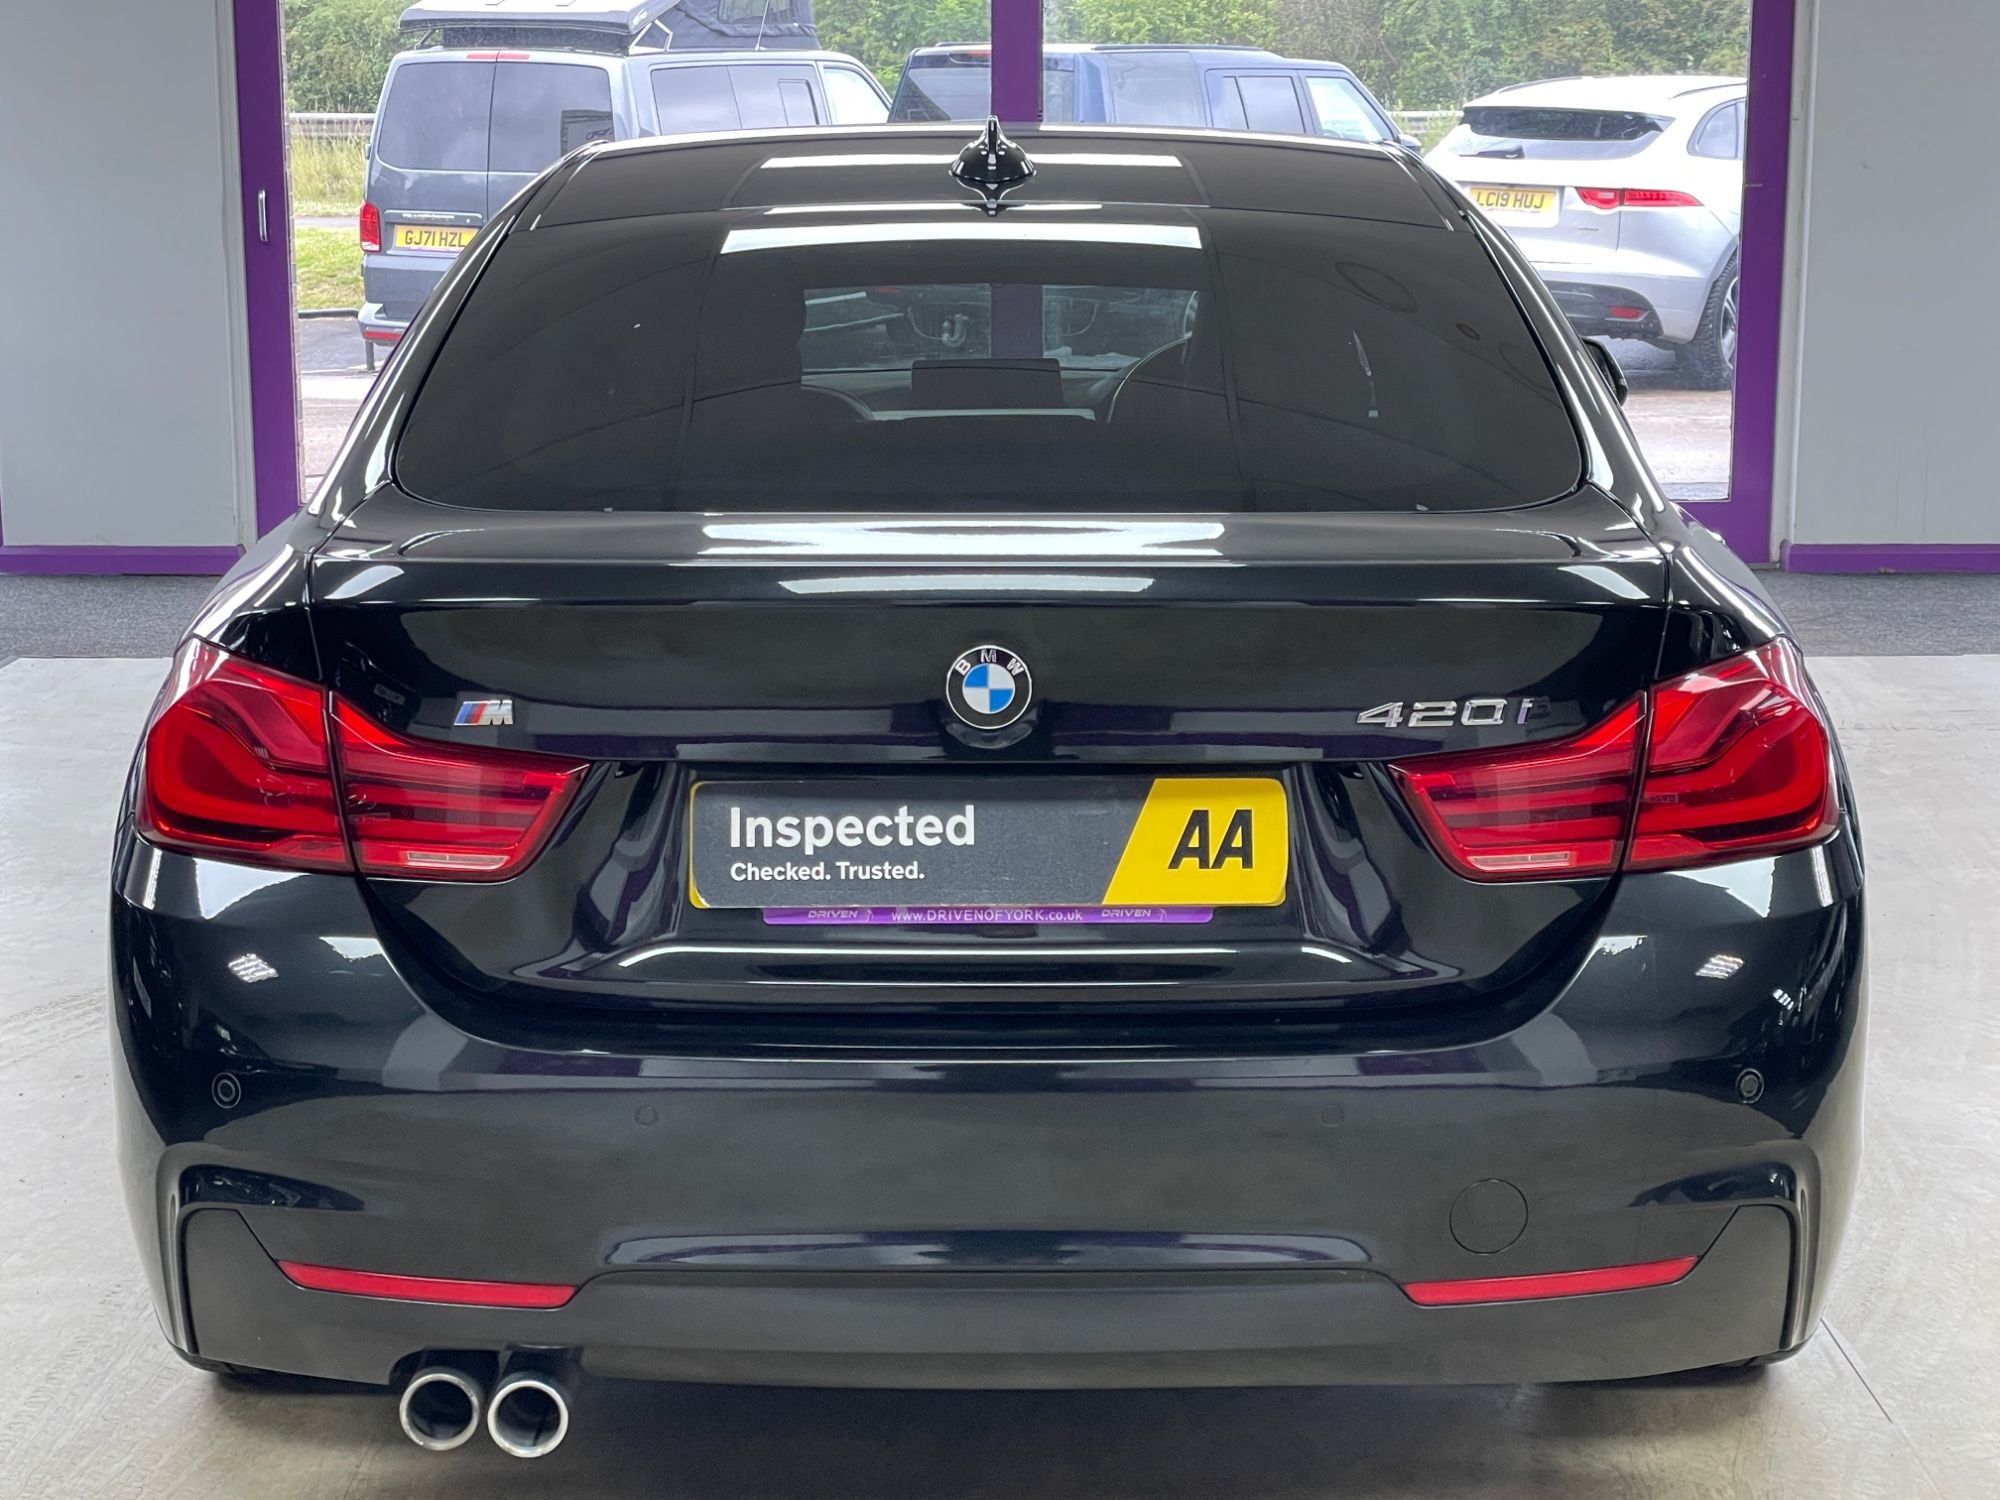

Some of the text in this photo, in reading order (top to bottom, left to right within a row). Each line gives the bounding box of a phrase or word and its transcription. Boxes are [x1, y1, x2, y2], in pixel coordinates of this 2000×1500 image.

[1476, 191, 1545, 209] LC19 HUJ
[404, 230, 466, 248] GJ71 HZL
[955, 649, 1025, 676] BMW
[1356, 697, 1535, 728] 420i
[730, 804, 975, 855] Inspected
[1167, 809, 1253, 869] AA
[730, 861, 925, 881] Checked. Trusted.
[807, 910, 858, 919] DRIVEN
[892, 909, 1083, 922] www.DRIVENOFYORK.co.uk
[1101, 908, 1151, 918] DRIVEN
